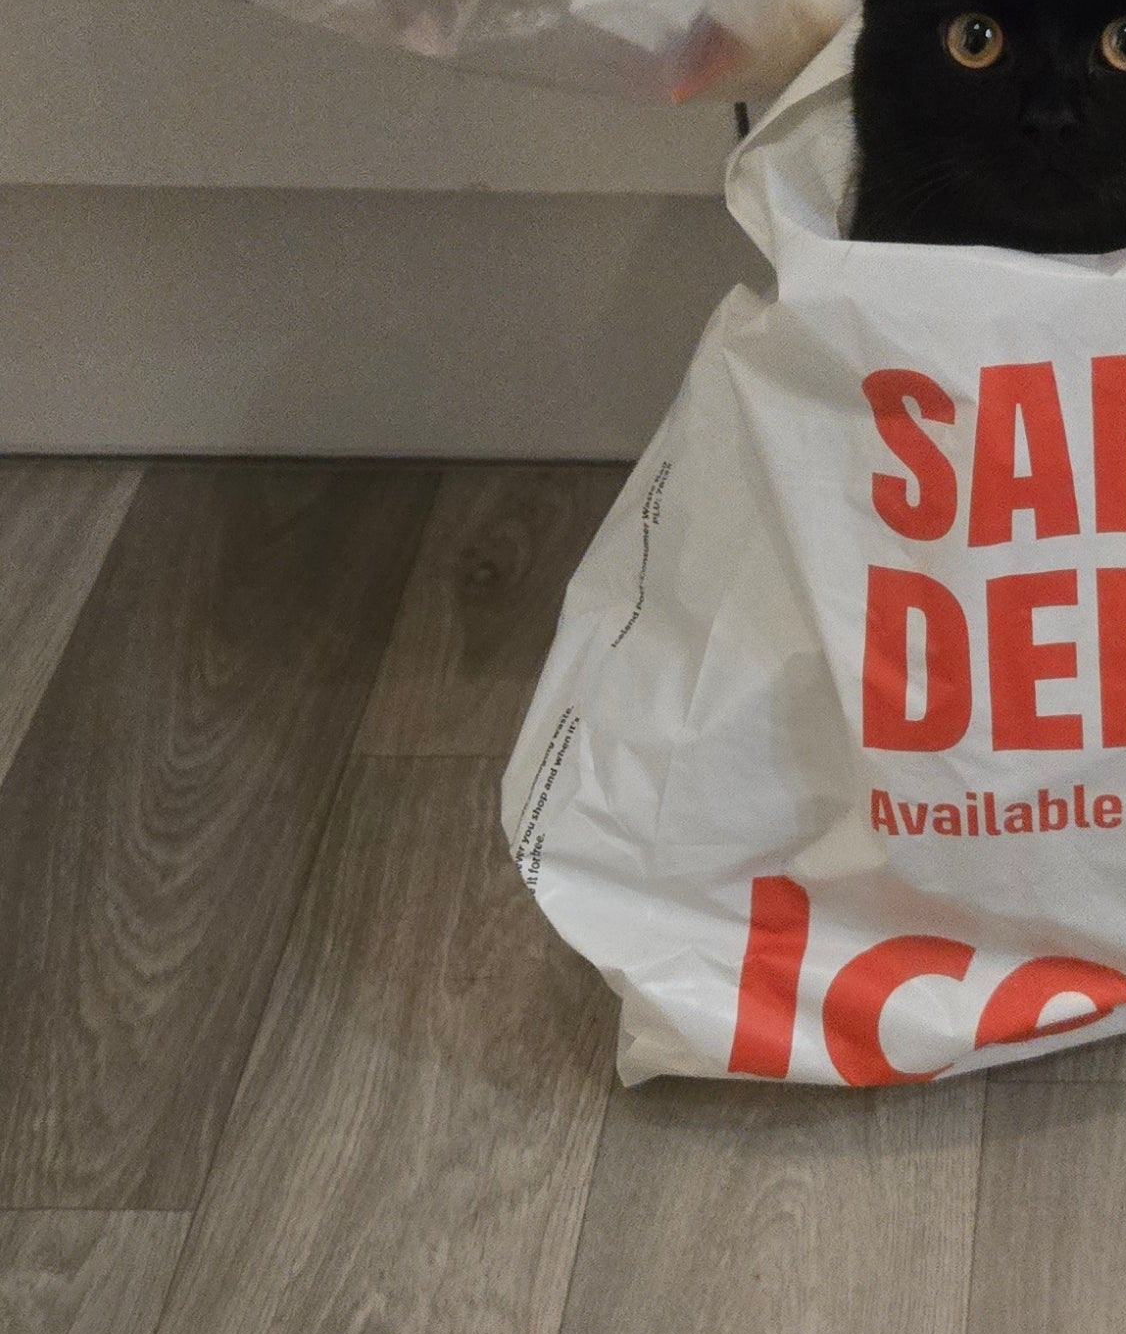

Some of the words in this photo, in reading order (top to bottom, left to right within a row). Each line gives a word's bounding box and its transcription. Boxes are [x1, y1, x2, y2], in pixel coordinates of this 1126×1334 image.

[522, 822, 536, 845] you
[532, 791, 549, 821] shop
[545, 767, 558, 791] and
[555, 736, 571, 766] when
[871, 786, 1123, 837] Available
